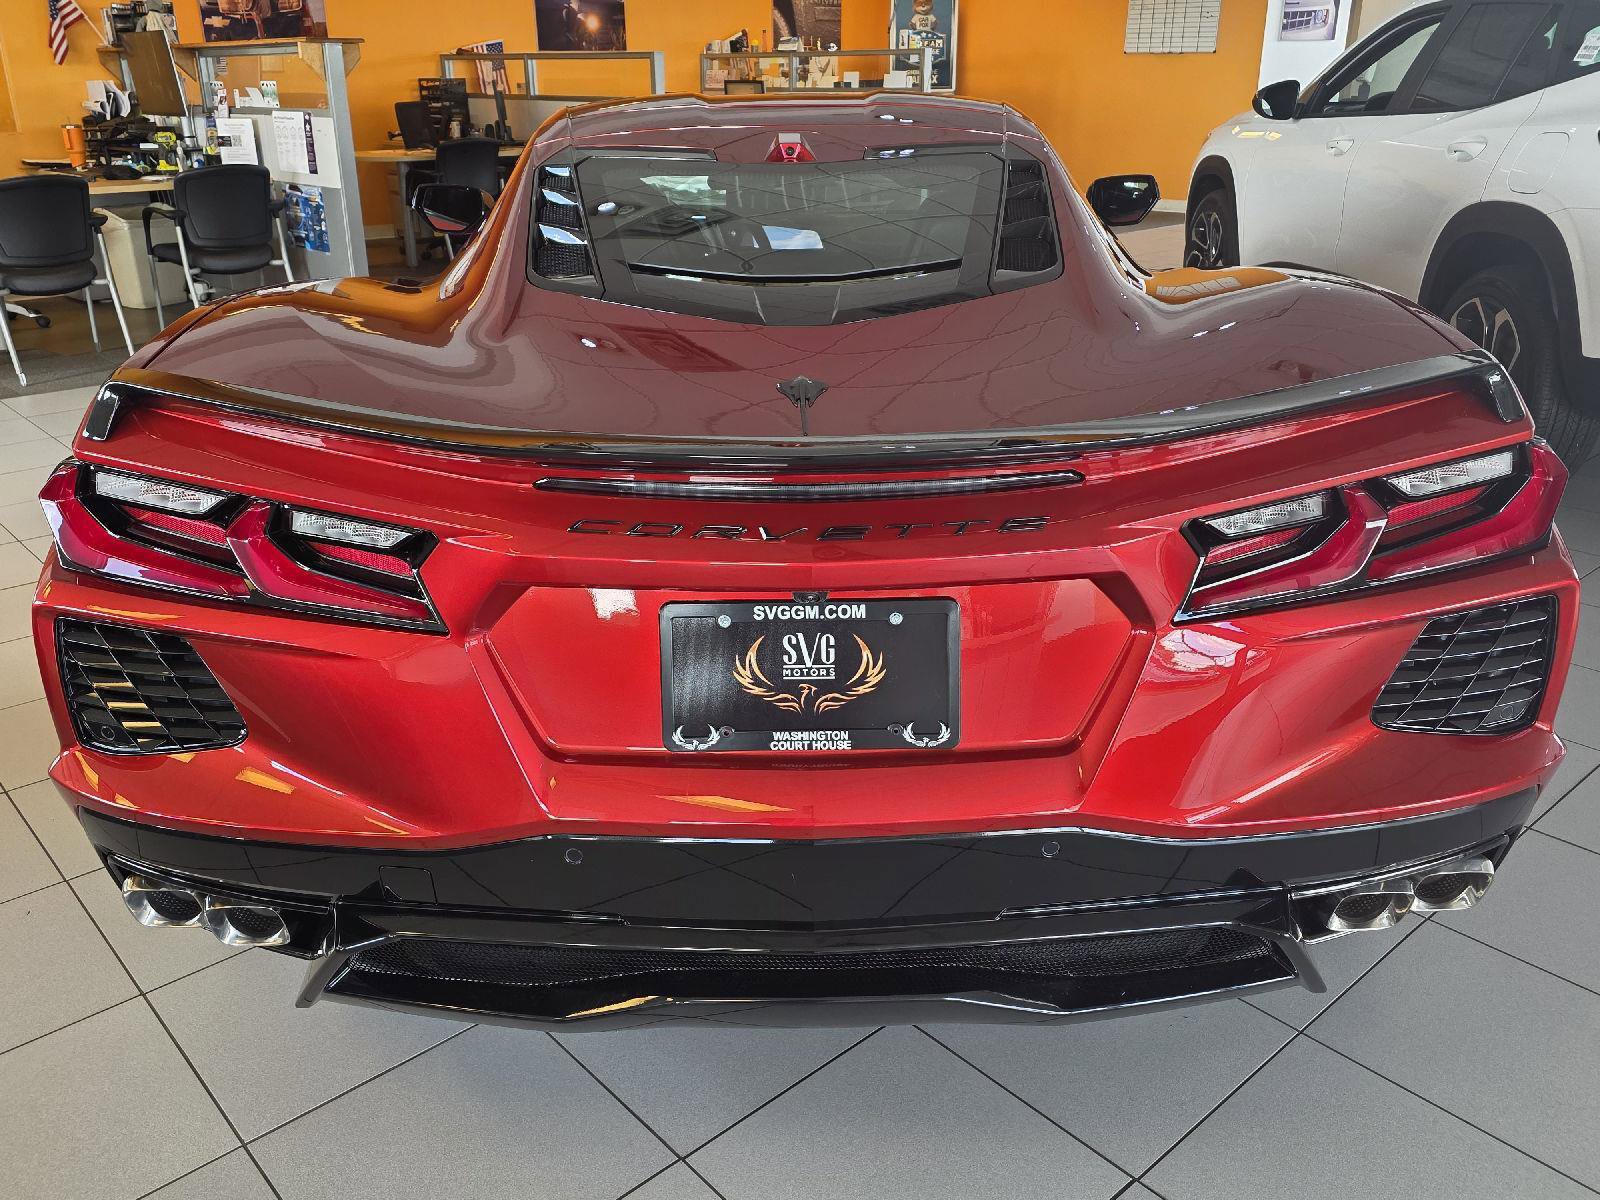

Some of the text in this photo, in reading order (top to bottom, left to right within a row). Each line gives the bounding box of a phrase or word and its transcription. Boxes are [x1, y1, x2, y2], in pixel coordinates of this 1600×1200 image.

[566, 515, 1051, 542] CORVETTE
[753, 604, 866, 620] SVGGM.COM
[783, 632, 836, 667] SVG
[783, 668, 836, 676] MOTORS
[772, 731, 849, 740] WASHINGTON
[770, 741, 852, 751] COURT HOUSE
